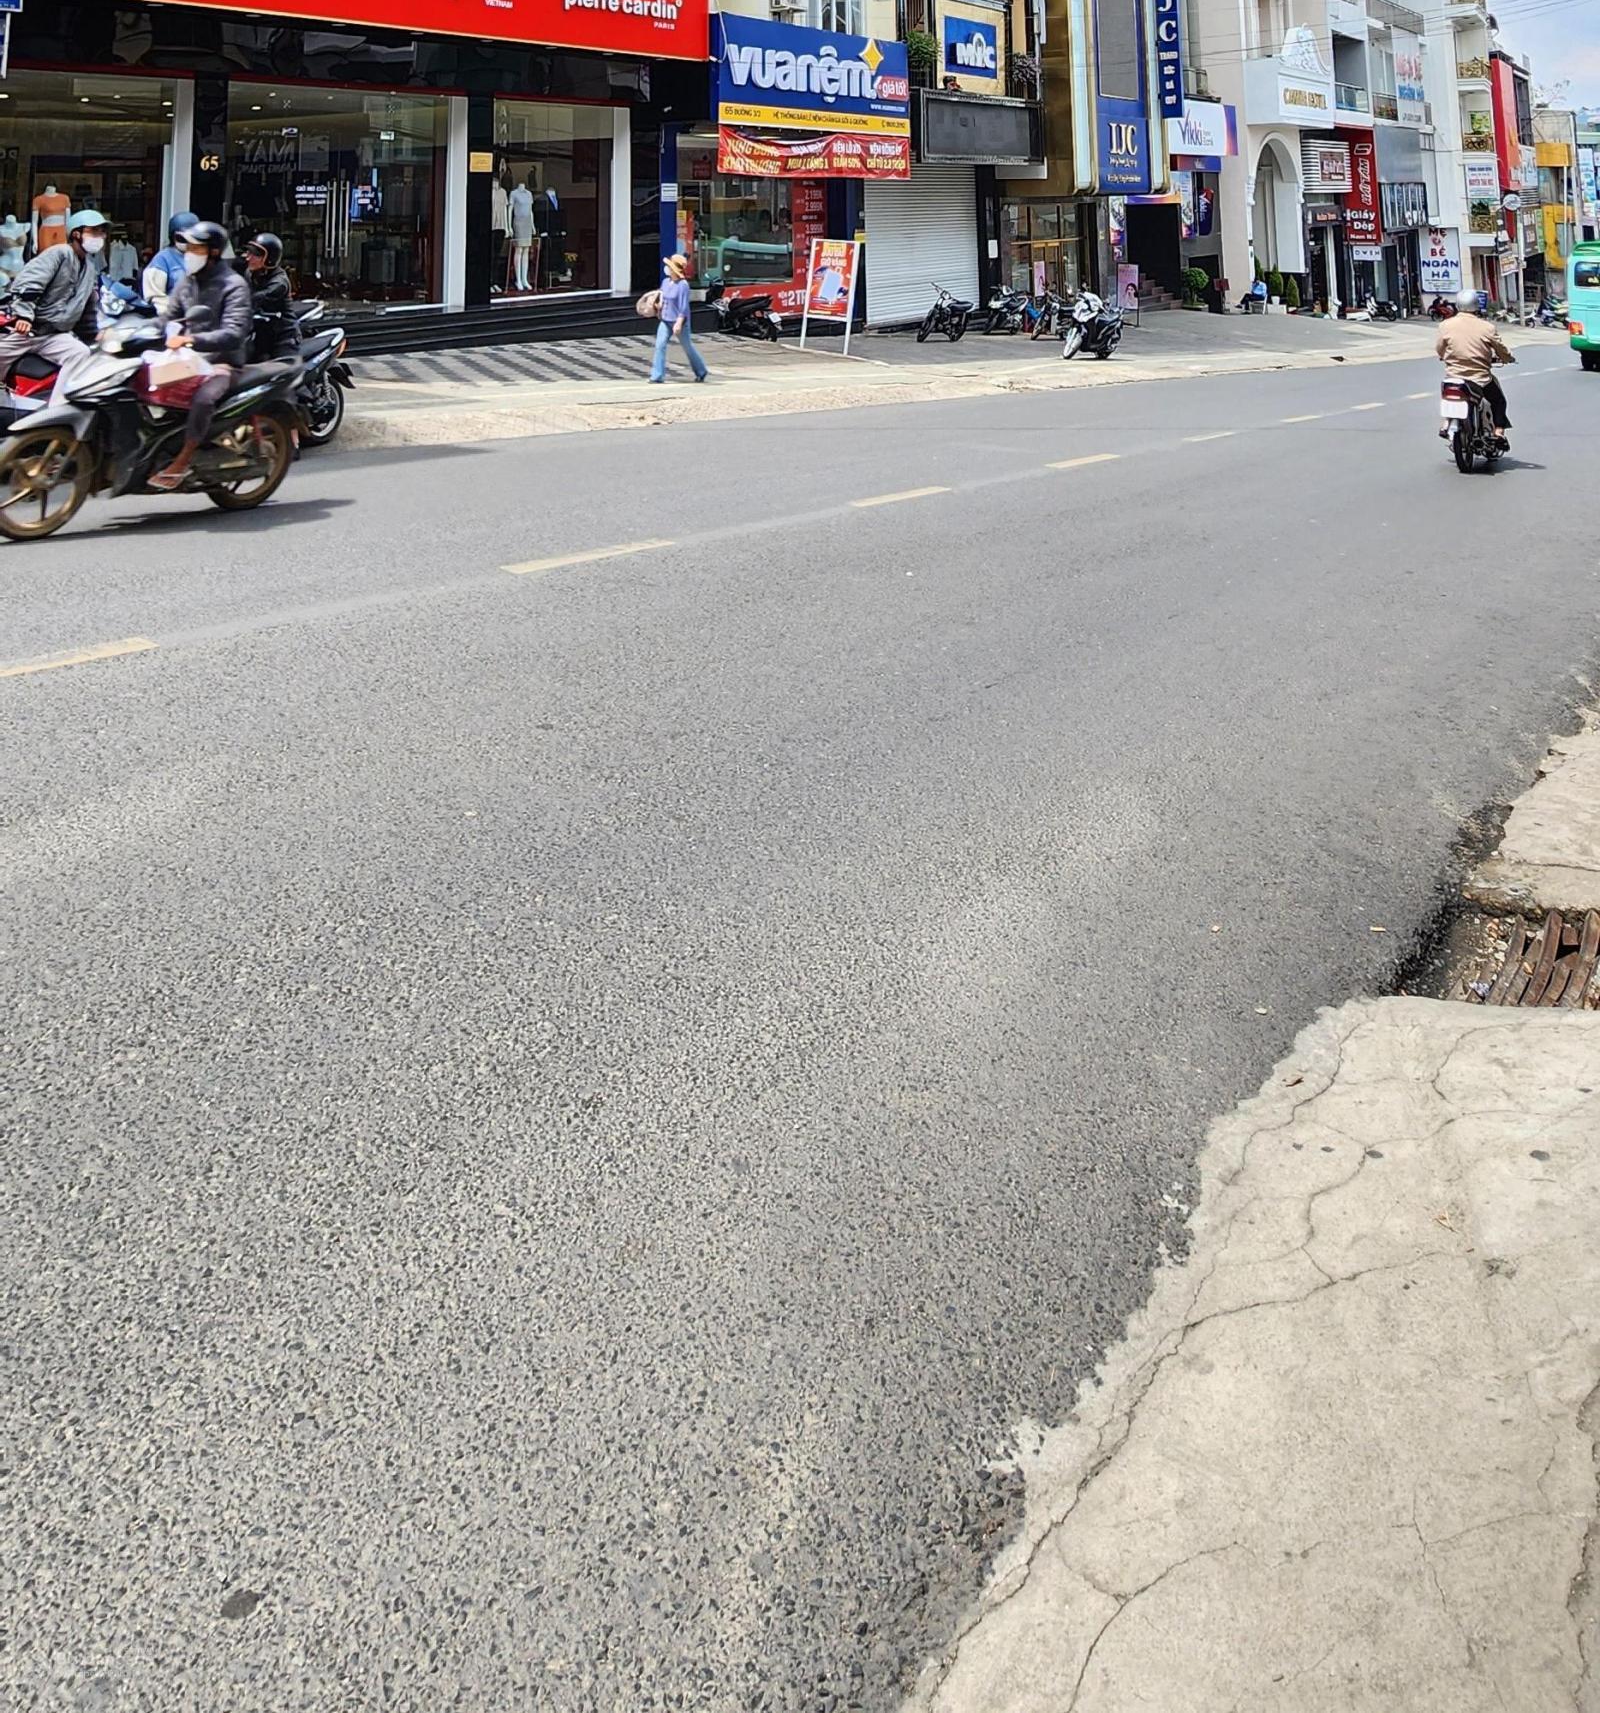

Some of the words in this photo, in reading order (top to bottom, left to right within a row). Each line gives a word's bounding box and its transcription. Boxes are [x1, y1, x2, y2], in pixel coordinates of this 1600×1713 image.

[653, 21, 676, 31] PARIS
[1109, 123, 1138, 155] IJC
[1177, 108, 1202, 146] Vikki
[200, 155, 219, 171] 65
